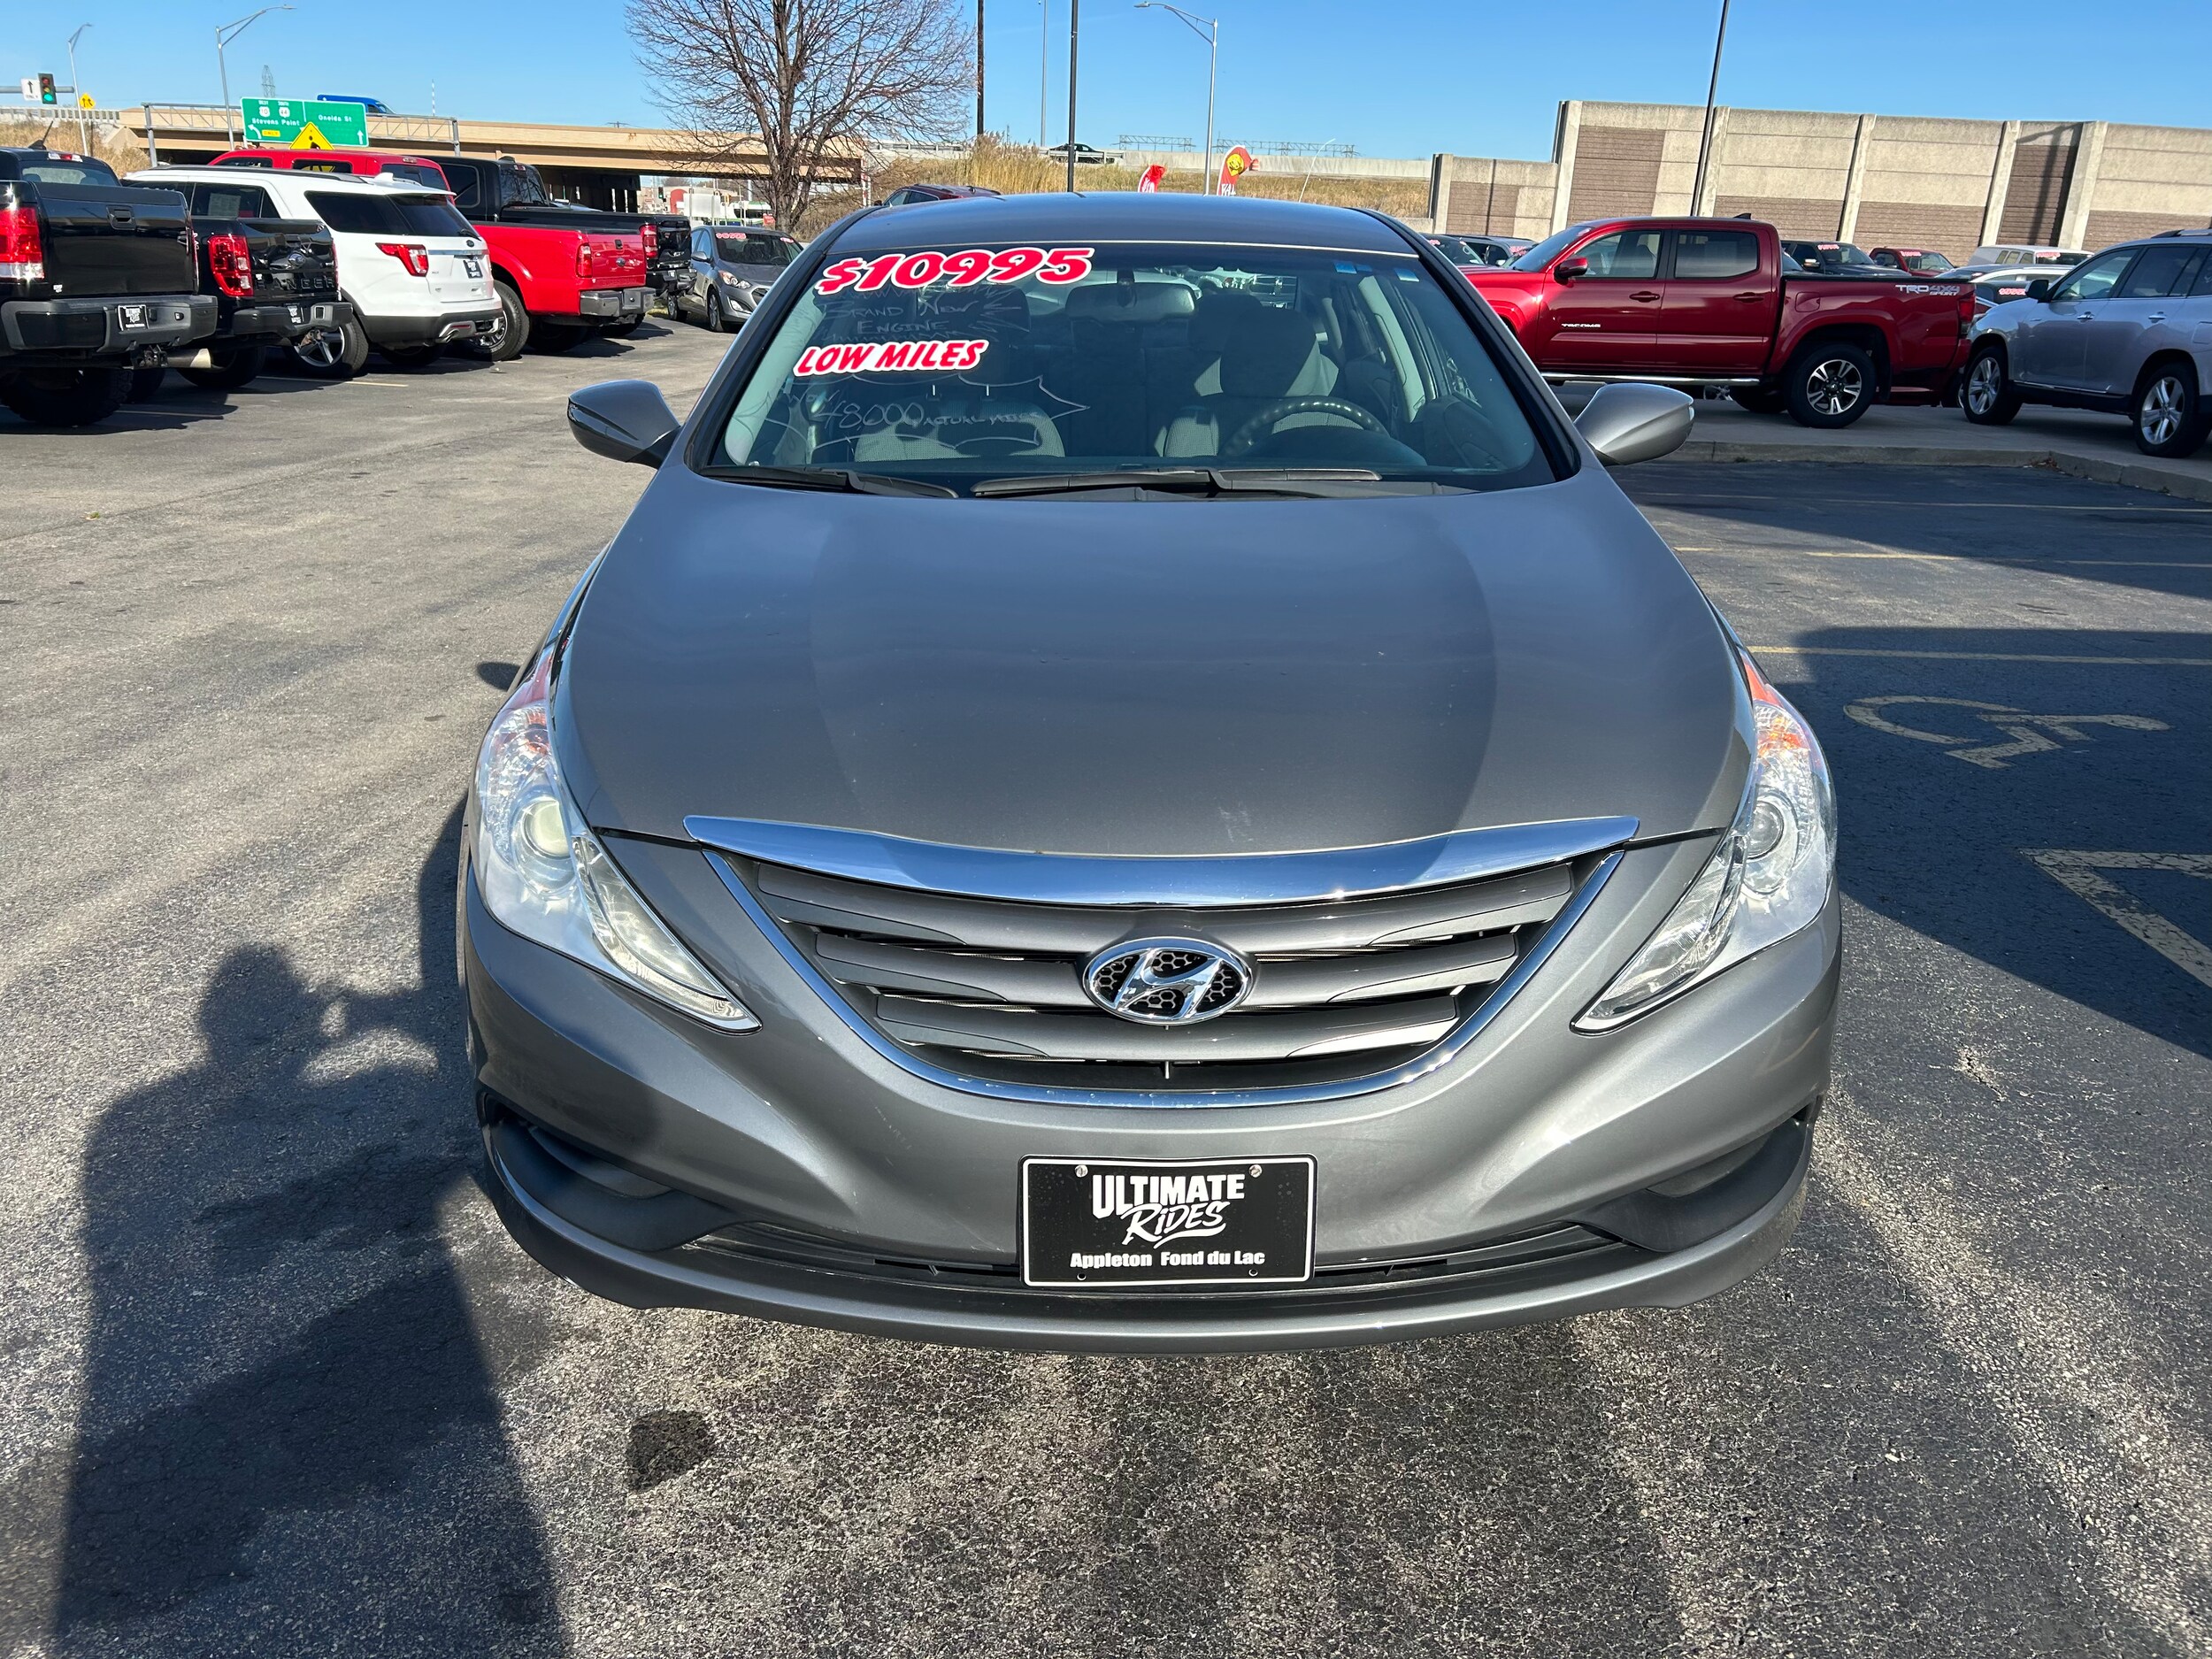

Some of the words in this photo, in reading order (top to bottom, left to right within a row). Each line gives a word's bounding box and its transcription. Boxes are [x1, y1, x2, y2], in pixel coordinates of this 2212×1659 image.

[256, 277, 335, 290] RANGER
[815, 247, 1095, 296] $10995
[1895, 284, 1929, 294] TRD
[857, 319, 949, 334] ENGINE
[795, 343, 873, 376] LOW
[877, 340, 989, 371] MILES
[814, 397, 925, 430] 48,000
[925, 416, 985, 426] ACTUAL
[1091, 1174, 1245, 1219] ULTIMATE
[1070, 1251, 1153, 1269] Appleton
[1160, 1251, 1204, 1267] Fond
[1207, 1250, 1231, 1265] du
[1234, 1250, 1265, 1265] Lac
